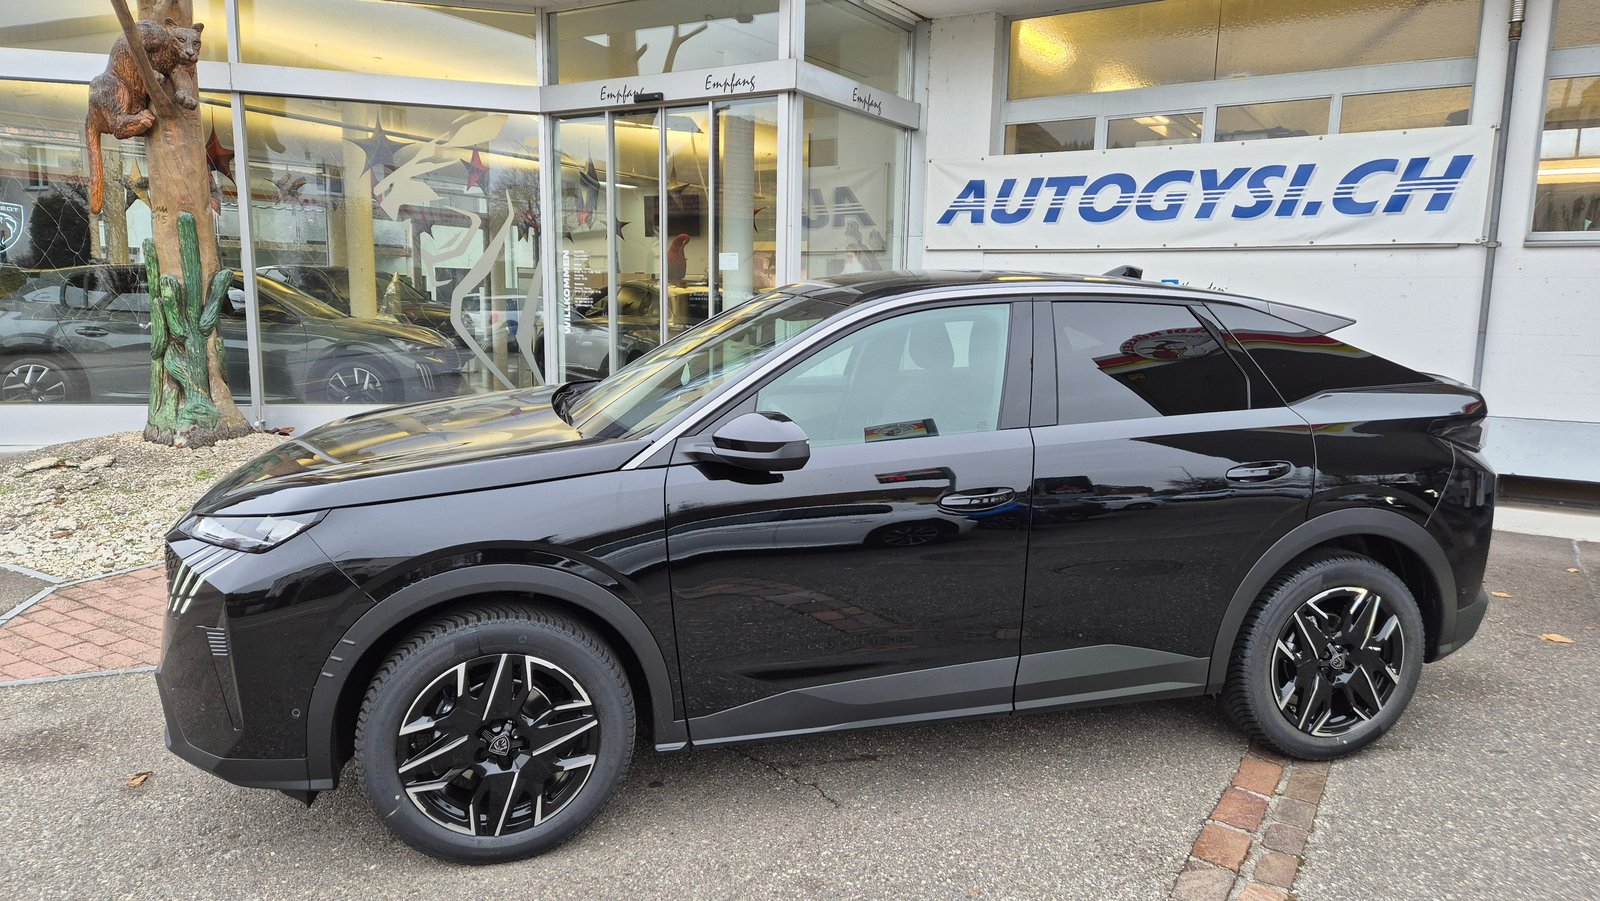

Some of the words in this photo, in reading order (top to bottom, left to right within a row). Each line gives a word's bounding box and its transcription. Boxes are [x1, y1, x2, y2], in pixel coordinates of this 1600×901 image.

[705, 73, 755, 93] Empfang
[852, 87, 882, 115] Empfang
[936, 154, 1474, 225] AUTOGYSI.CH
[562, 249, 572, 335] WILLKOMMEN
